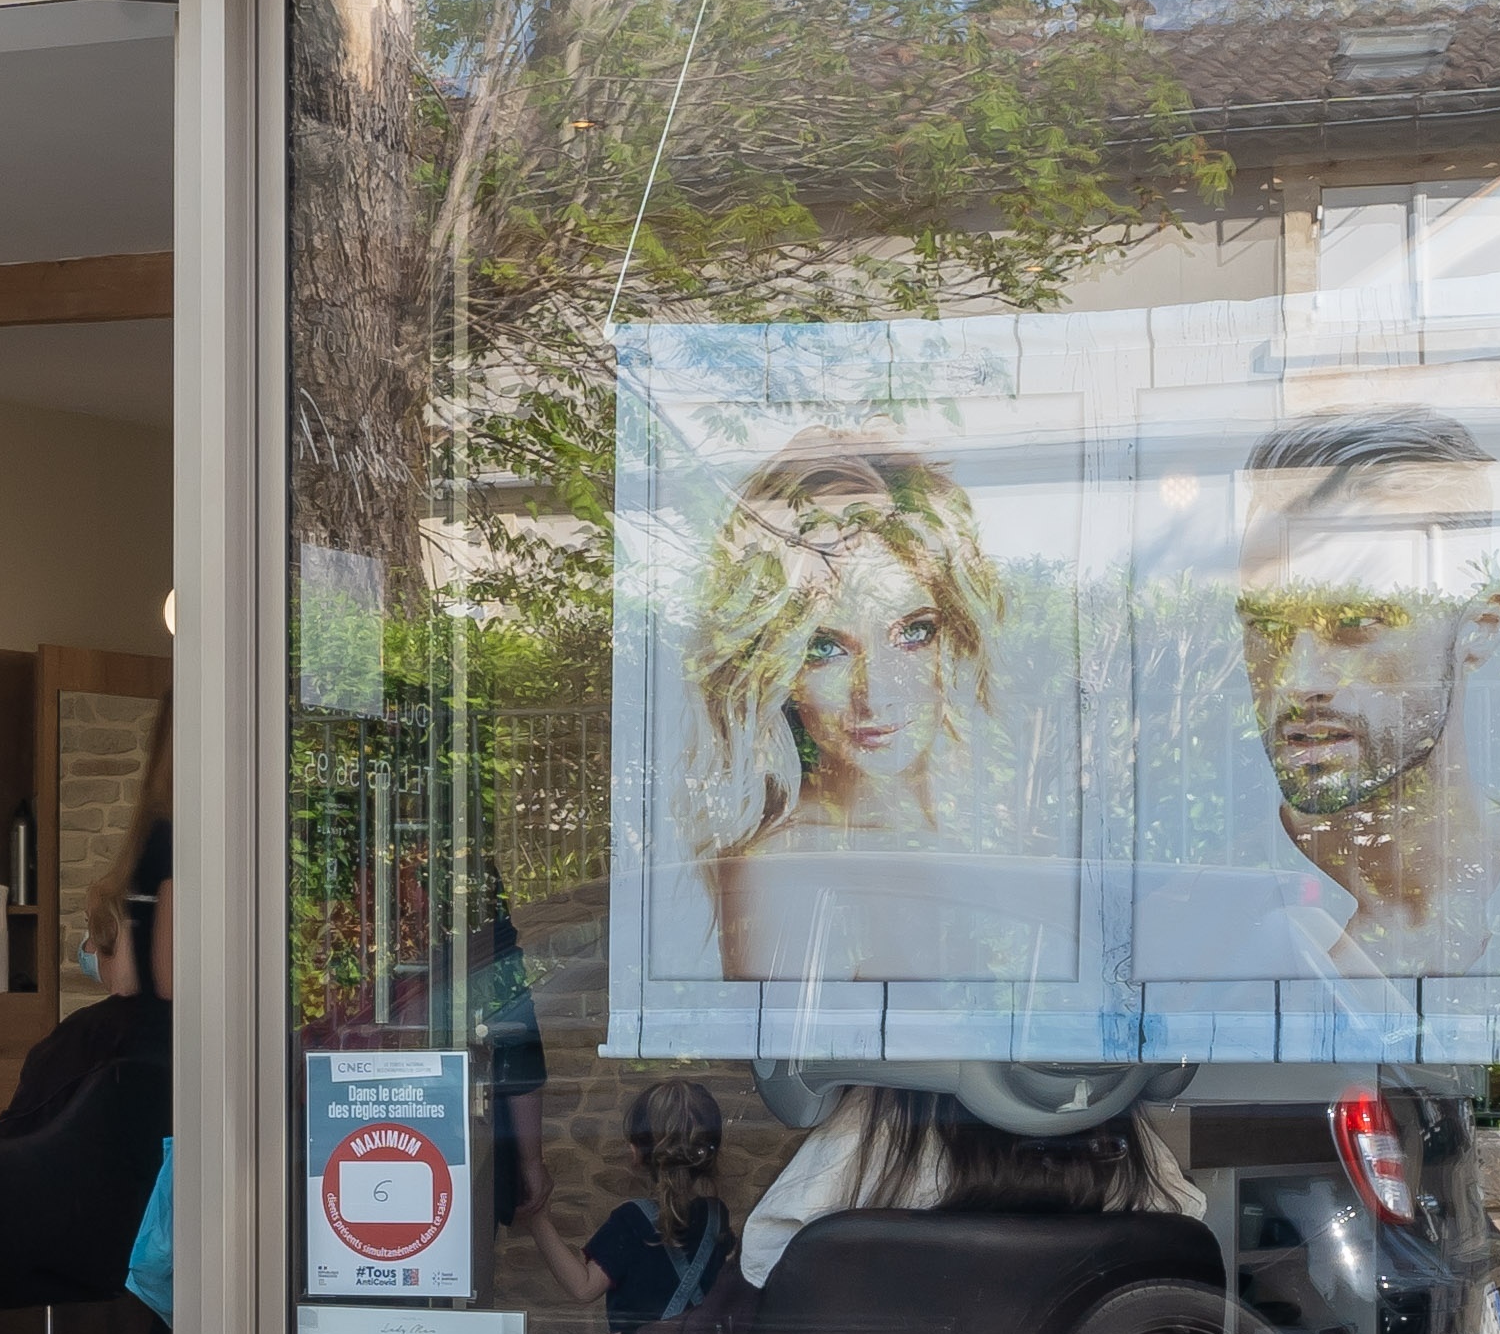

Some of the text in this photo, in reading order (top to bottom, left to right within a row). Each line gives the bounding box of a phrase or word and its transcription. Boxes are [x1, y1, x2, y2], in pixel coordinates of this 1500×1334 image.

[337, 1062, 372, 1074] CNEC
[348, 1084, 424, 1102] Dans le cadre
[328, 1101, 445, 1120] des règles sanitaires
[350, 1129, 422, 1158] MAXIMUM
[373, 1179, 393, 1203] 6
[326, 1192, 340, 1222] clients
[356, 1266, 397, 1279] #Tous
[356, 1278, 397, 1287] AntiCovid
